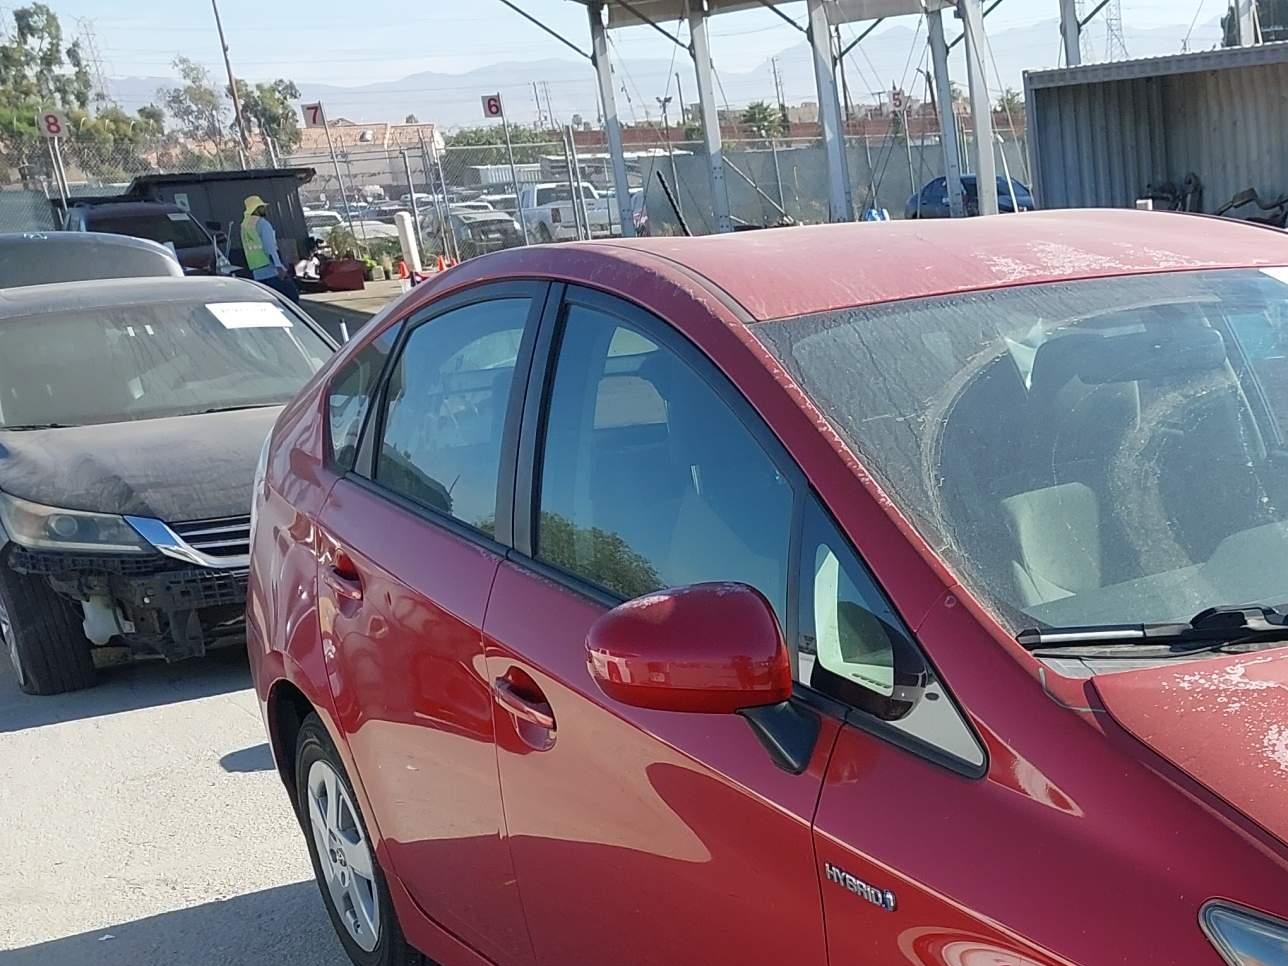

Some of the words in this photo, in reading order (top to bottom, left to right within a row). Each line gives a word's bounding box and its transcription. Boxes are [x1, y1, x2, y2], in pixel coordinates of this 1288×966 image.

[487, 97, 499, 115] 6
[892, 92, 902, 108] 5
[45, 114, 61, 134] 8
[306, 105, 319, 125] 7
[825, 863, 882, 907] HYBRID
